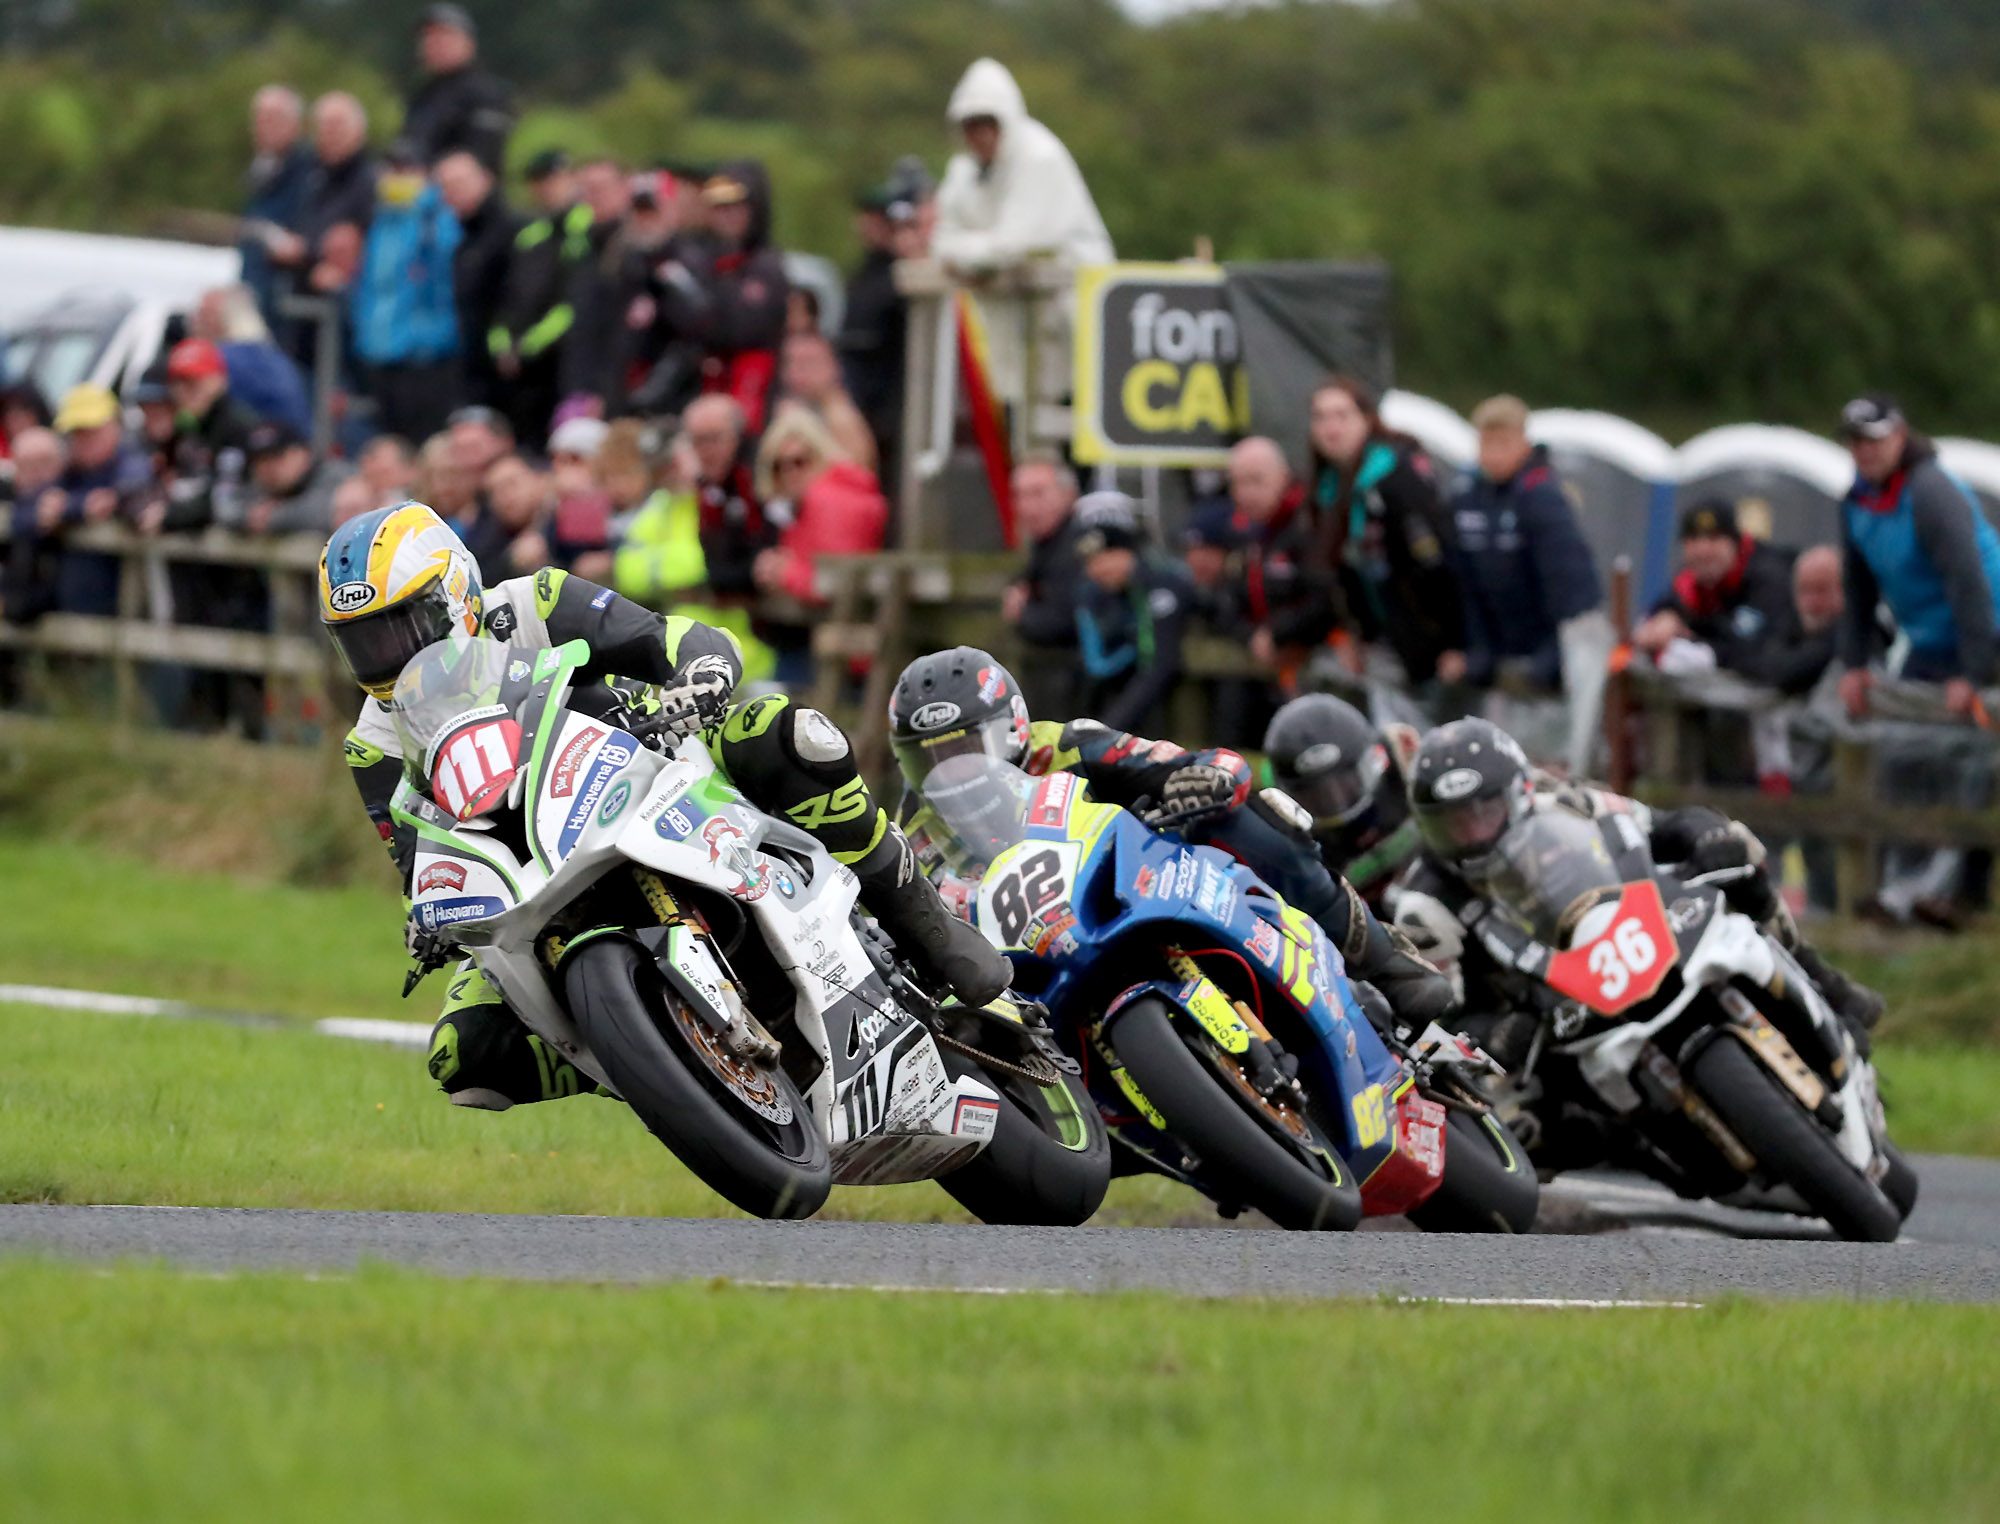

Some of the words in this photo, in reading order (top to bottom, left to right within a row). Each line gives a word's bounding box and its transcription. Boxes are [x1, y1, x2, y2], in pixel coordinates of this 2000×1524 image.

[333, 585, 369, 607] Arai
[916, 705, 956, 726] Arai
[438, 723, 514, 819] 111
[567, 765, 614, 831] Husqvarna
[660, 778, 688, 807] Motorrad
[436, 905, 485, 921] Husqvarna
[991, 848, 1065, 948] 82
[1588, 916, 1657, 1000] 36
[840, 1061, 882, 1140] 111
[1351, 1083, 1388, 1150] 82
